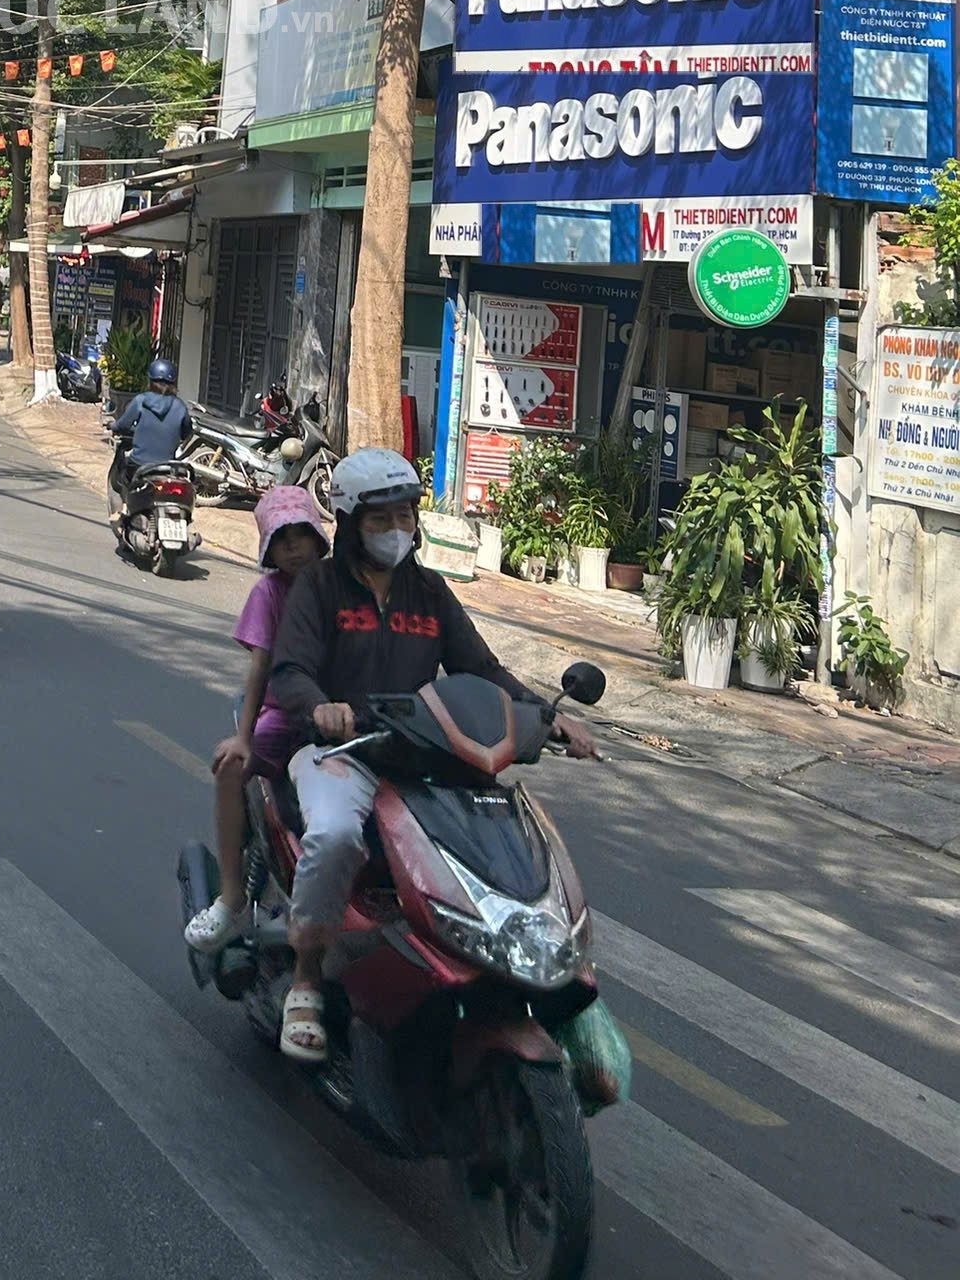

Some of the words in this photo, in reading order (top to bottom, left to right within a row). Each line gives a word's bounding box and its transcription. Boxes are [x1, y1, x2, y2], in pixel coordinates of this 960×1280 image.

[841, 6, 867, 15] CÔNG
[880, 9, 904, 18] TNHH
[840, 30, 946, 48] thietbidientt.com
[687, 56, 811, 72] THIETBIDIENTT.COM
[455, 73, 763, 168] Panasonic
[673, 207, 798, 225] THIETBIDIENTT.COM
[435, 222, 456, 241] NHÀ
[673, 230, 680, 239] 17
[767, 230, 797, 240] TP.HCM
[712, 265, 772, 286] Schneider
[741, 275, 774, 287] Electric
[543, 279, 577, 293] CÔNG
[580, 284, 592, 294] TY
[596, 286, 628, 299] TNHH
[490, 300, 519, 309] CADIVI
[914, 334, 939, 358] KHÁM
[883, 361, 903, 379] BS.
[907, 361, 922, 381] VÕ
[642, 389, 671, 402] PHIS
[888, 384, 922, 397] CHUYÊN
[924, 389, 949, 401] KHOA
[923, 431, 929, 446] &
[901, 461, 906, 469] 2
[900, 486, 906, 494] 7
